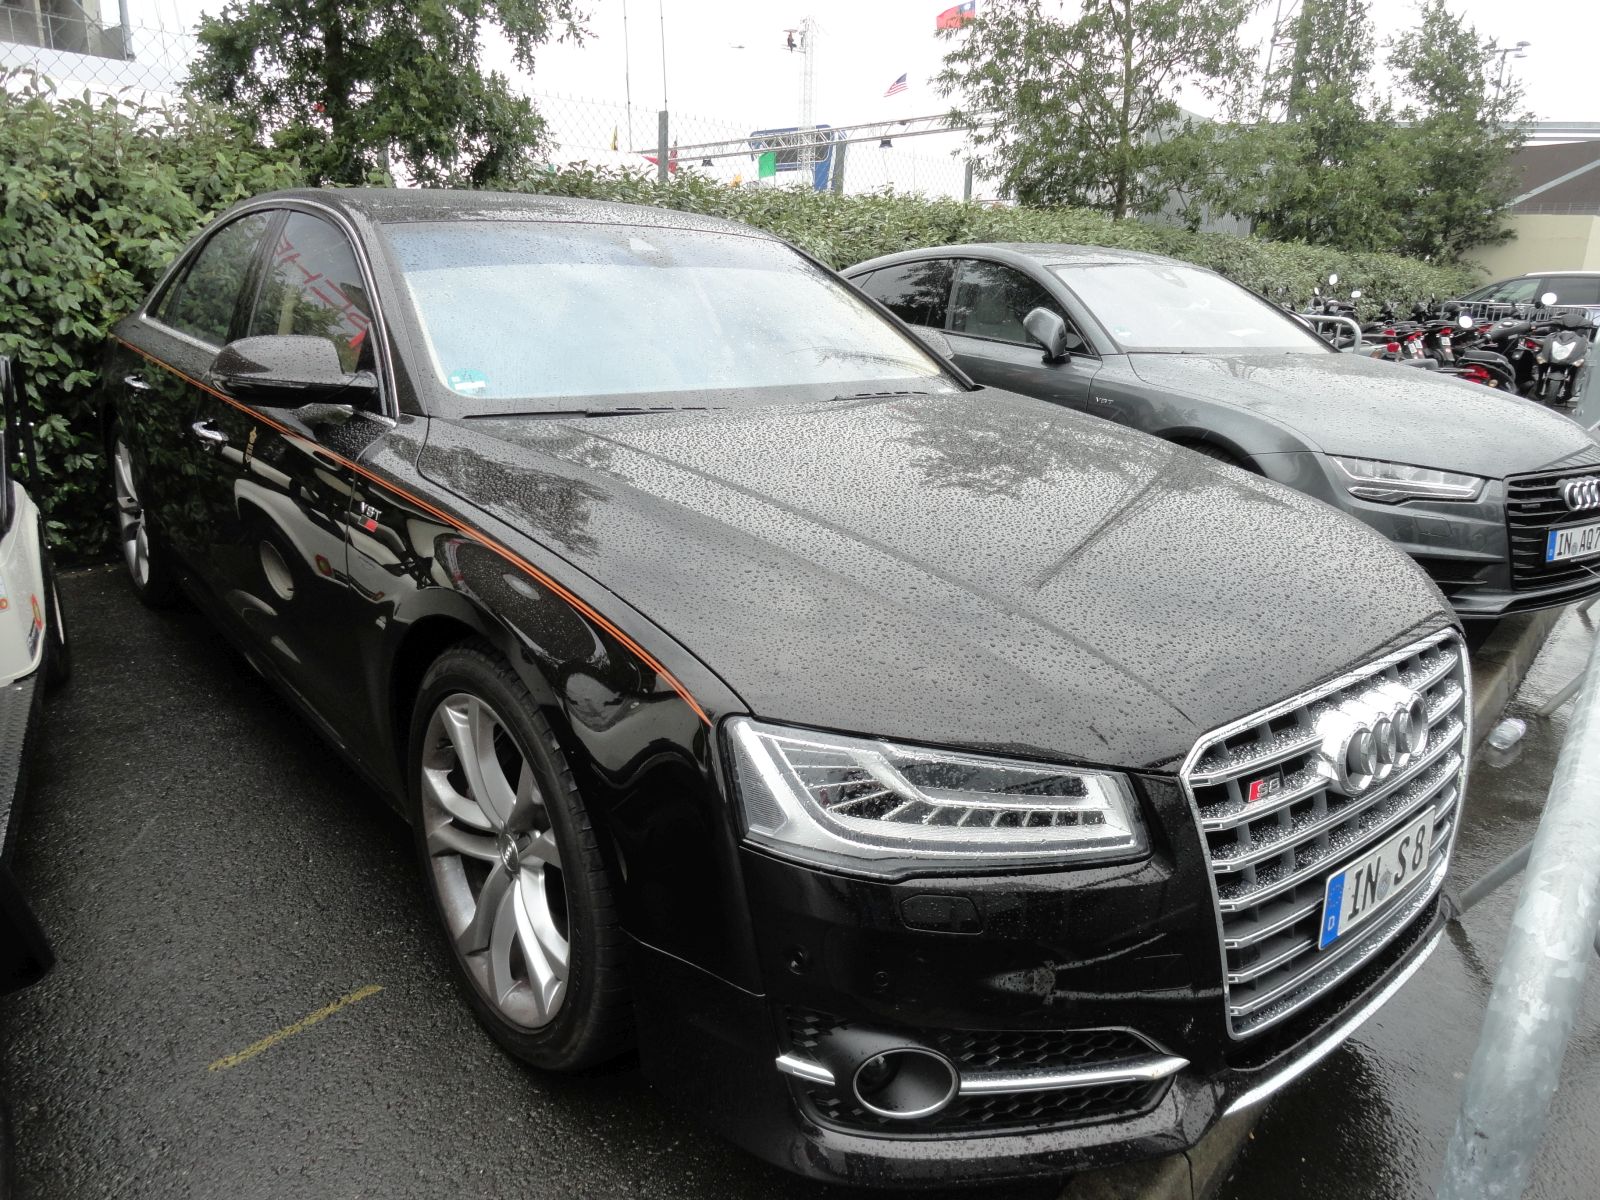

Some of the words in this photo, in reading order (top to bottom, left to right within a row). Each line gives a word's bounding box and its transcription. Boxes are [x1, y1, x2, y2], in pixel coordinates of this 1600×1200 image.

[360, 501, 382, 521] V8T
[1557, 532, 1573, 556] IN
[1257, 778, 1280, 798] S8
[1347, 855, 1381, 921] IN
[1394, 824, 1425, 885] S8
[1327, 915, 1335, 931] D
